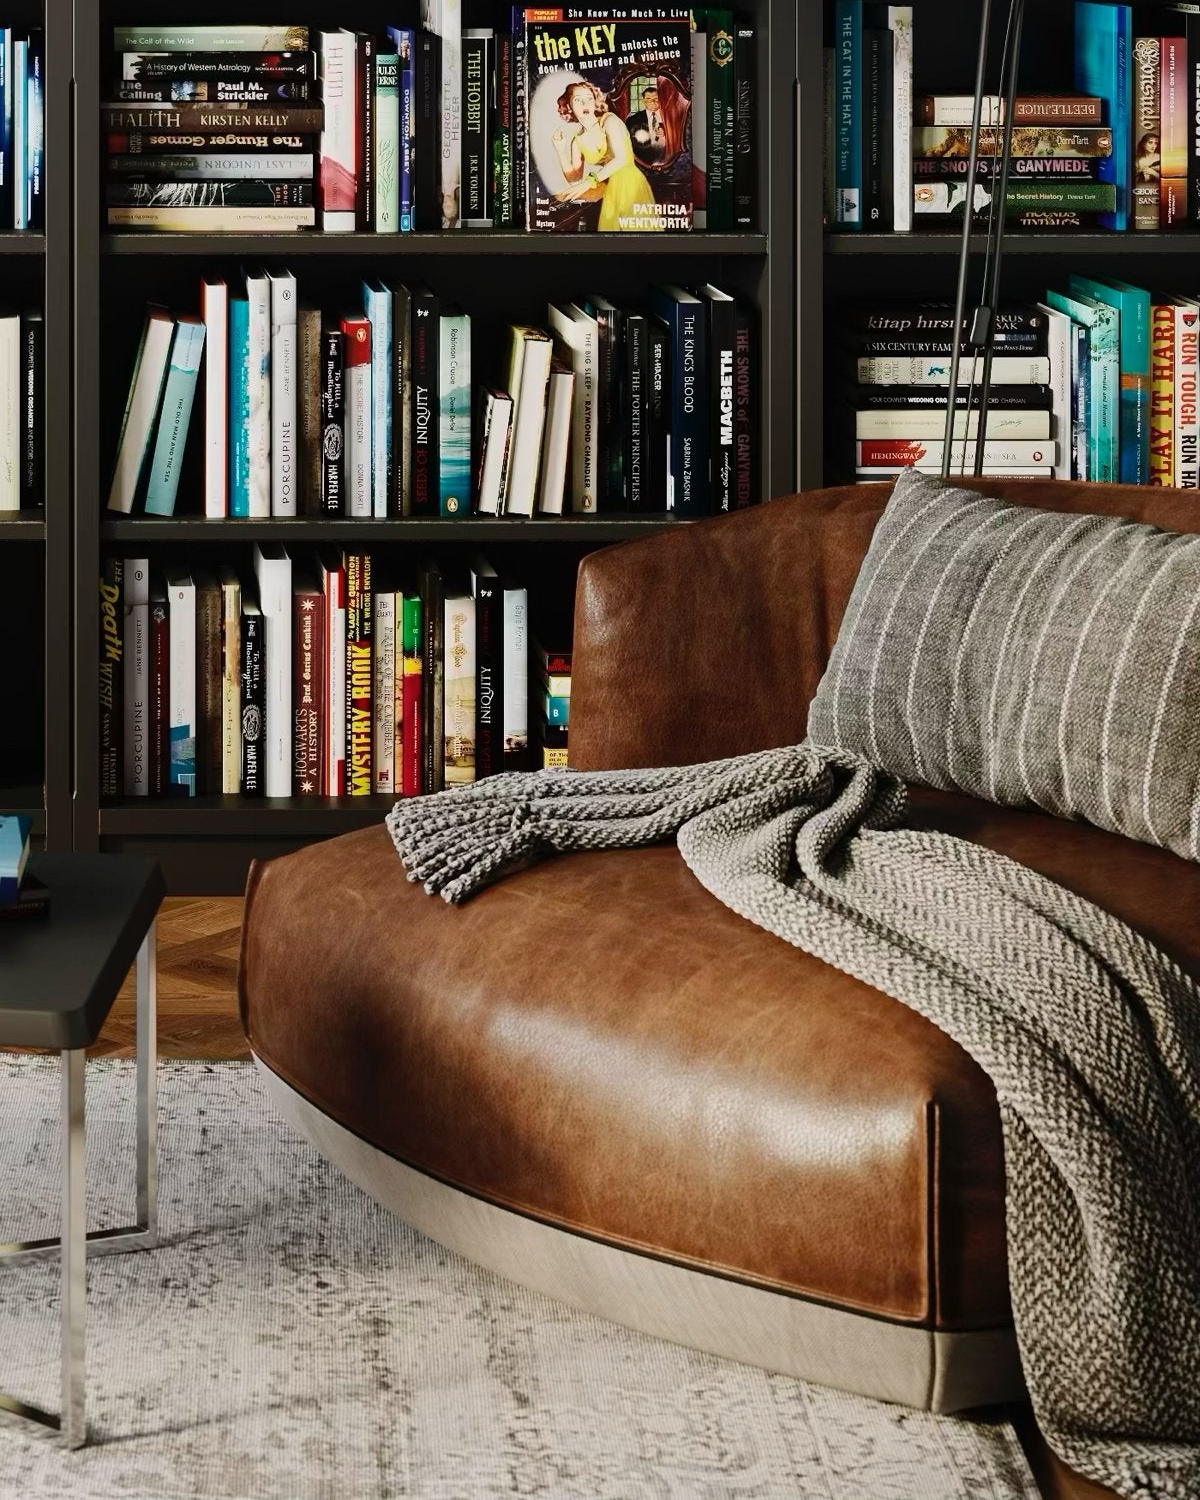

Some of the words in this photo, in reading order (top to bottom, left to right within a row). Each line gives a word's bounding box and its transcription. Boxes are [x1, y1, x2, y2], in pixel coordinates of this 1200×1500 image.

[568, 9, 582, 17] She
[534, 32, 571, 62] the
[575, 24, 616, 57] KEY
[621, 38, 658, 51] unlocks
[663, 35, 679, 45] the
[153, 64, 178, 73] History
[179, 63, 187, 71] of
[188, 63, 216, 71] Western
[218, 63, 251, 73] Astrology
[468, 50, 481, 80] THE
[538, 65, 558, 75] door
[564, 62, 574, 71] to
[580, 56, 613, 69] murder
[618, 53, 635, 65] and
[641, 49, 681, 62] violence
[120, 91, 163, 101] Calling
[217, 82, 246, 91] Paul
[248, 82, 263, 91] M.
[217, 91, 269, 100] Strickler
[200, 115, 250, 126] KIRSTEN
[255, 115, 289, 126] KELLY
[443, 79, 451, 159] GEORGETTE
[451, 96, 459, 141] HEYER
[468, 82, 481, 133] HOBBIT
[1017, 104, 1095, 115] BEETLEJUICE
[150, 136, 206, 147] Games
[210, 135, 268, 147] Hunger
[273, 136, 303, 147] The
[1056, 136, 1074, 145] Donna
[941, 161, 988, 173] SNOS
[1016, 160, 1090, 172] GANYMEDE
[633, 204, 687, 215] PATRICIA
[1039, 193, 1063, 201] History
[618, 217, 689, 229] WENTWORTH
[684, 315, 695, 335] THE
[867, 316, 911, 331] kitap
[684, 339, 695, 372] KING'S
[888, 343, 930, 351] CENTURY
[933, 344, 966, 352] FAMY
[1152, 306, 1174, 383] HARD
[1181, 332, 1196, 365] RUN
[323, 361, 334, 418] Mockingbird
[684, 376, 694, 413] BLOOD
[721, 351, 733, 445] MACBETH
[1178, 372, 1196, 430] TOUGH,
[417, 386, 431, 445] INIQUITY
[1152, 391, 1173, 418] IT
[1181, 435, 1196, 464] RUN
[328, 464, 338, 494] HARPER
[1181, 471, 1196, 488] HA
[328, 495, 338, 510] LEE
[100, 578, 123, 662] Death
[243, 642, 253, 699] Mockingbird
[100, 662, 112, 709] WISH
[134, 701, 143, 783] PORCUPINE
[296, 708, 307, 778] HOGWARTS
[309, 709, 318, 759] HISTORY
[352, 701, 371, 795] MYSTERY
[310, 767, 317, 776] A
